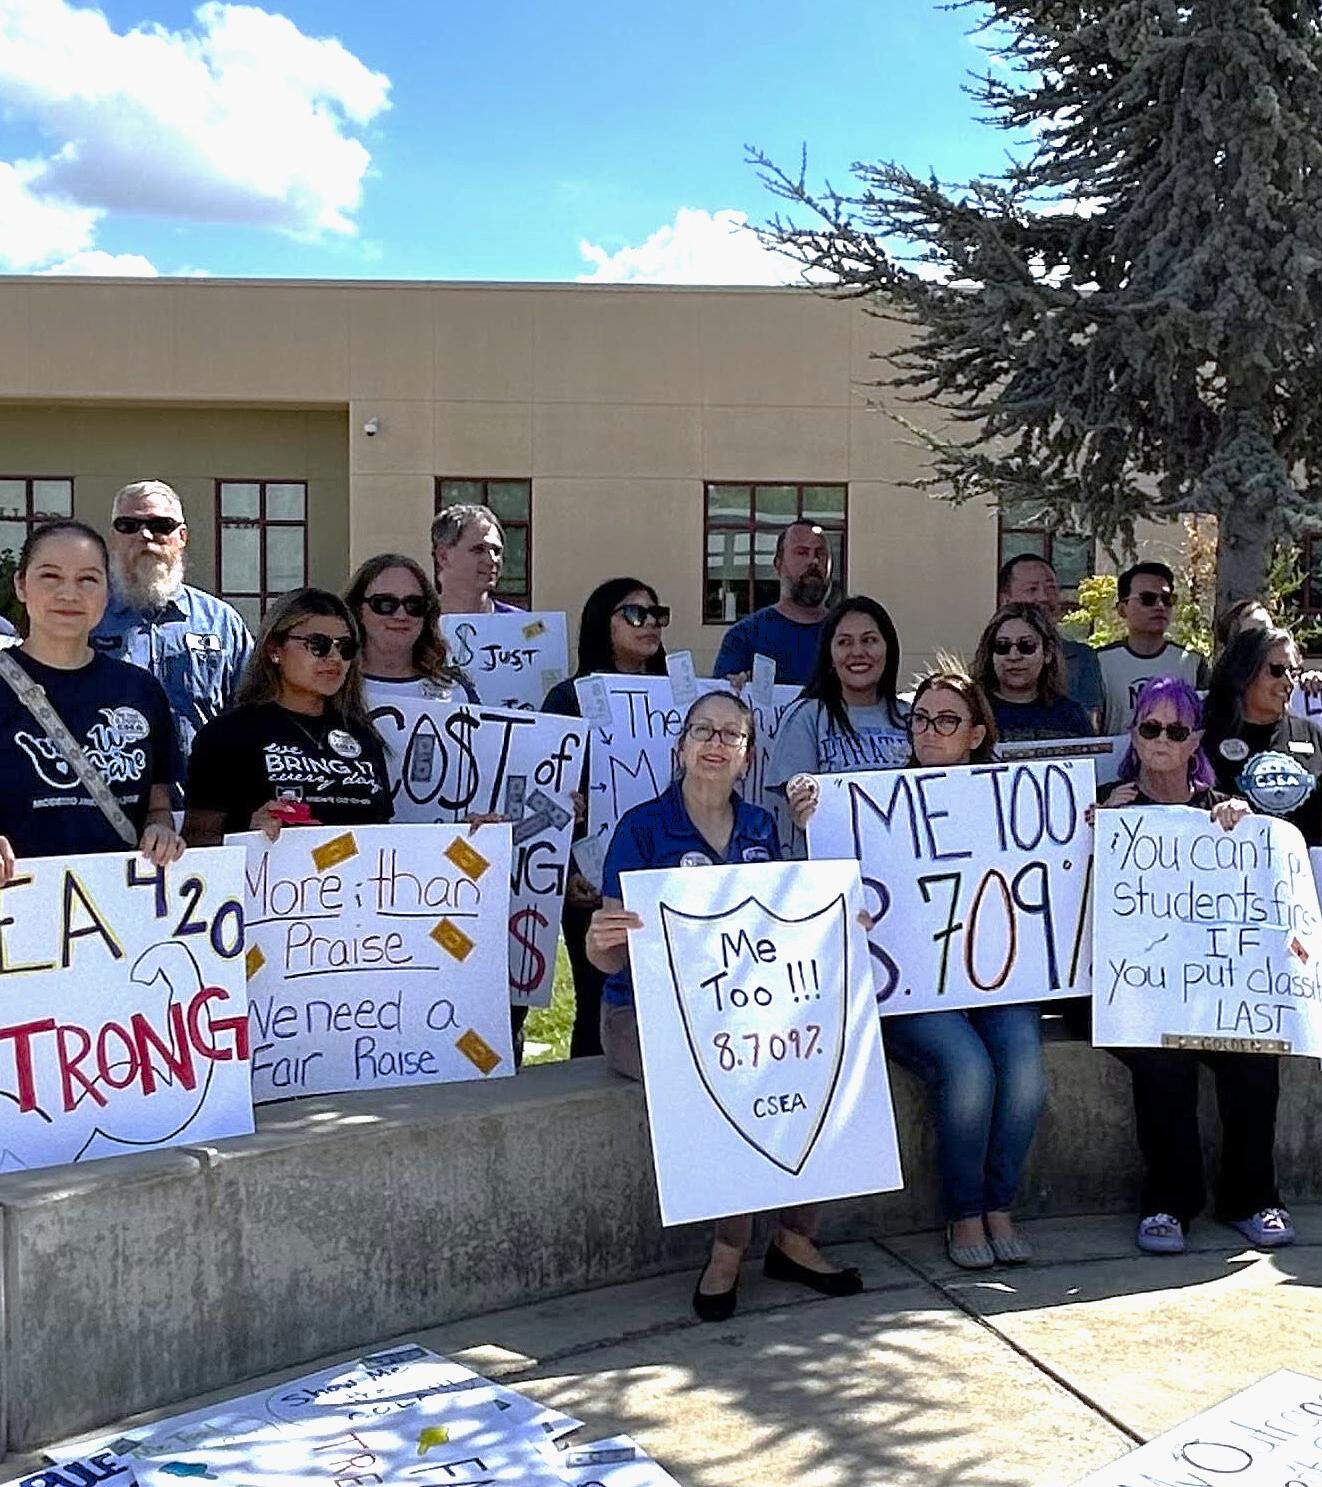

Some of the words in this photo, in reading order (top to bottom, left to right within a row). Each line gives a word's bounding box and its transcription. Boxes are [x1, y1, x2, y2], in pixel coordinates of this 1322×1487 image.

[479, 644, 541, 672] JUST
[265, 753, 352, 775] BRING
[534, 732, 581, 793] of
[1255, 774, 1300, 788] CSEA
[1119, 815, 1180, 871] You
[1190, 826, 1275, 871] can't
[246, 851, 342, 916] More
[369, 848, 481, 910] than
[1112, 875, 1268, 922] Students
[127, 856, 246, 959] 420
[285, 921, 414, 969] Praise
[720, 928, 777, 969] Me
[1204, 927, 1261, 958] IF
[700, 971, 772, 1012] Too
[1183, 957, 1235, 1003] put
[306, 990, 403, 1033] need
[427, 998, 458, 1031] a
[1216, 1000, 1297, 1035] LAST
[0, 986, 249, 1112] TRONG
[252, 1047, 324, 1088] Fair
[355, 1036, 439, 1078] Raise
[713, 1024, 824, 1073] 8.709%
[753, 1093, 808, 1120] CSEA
